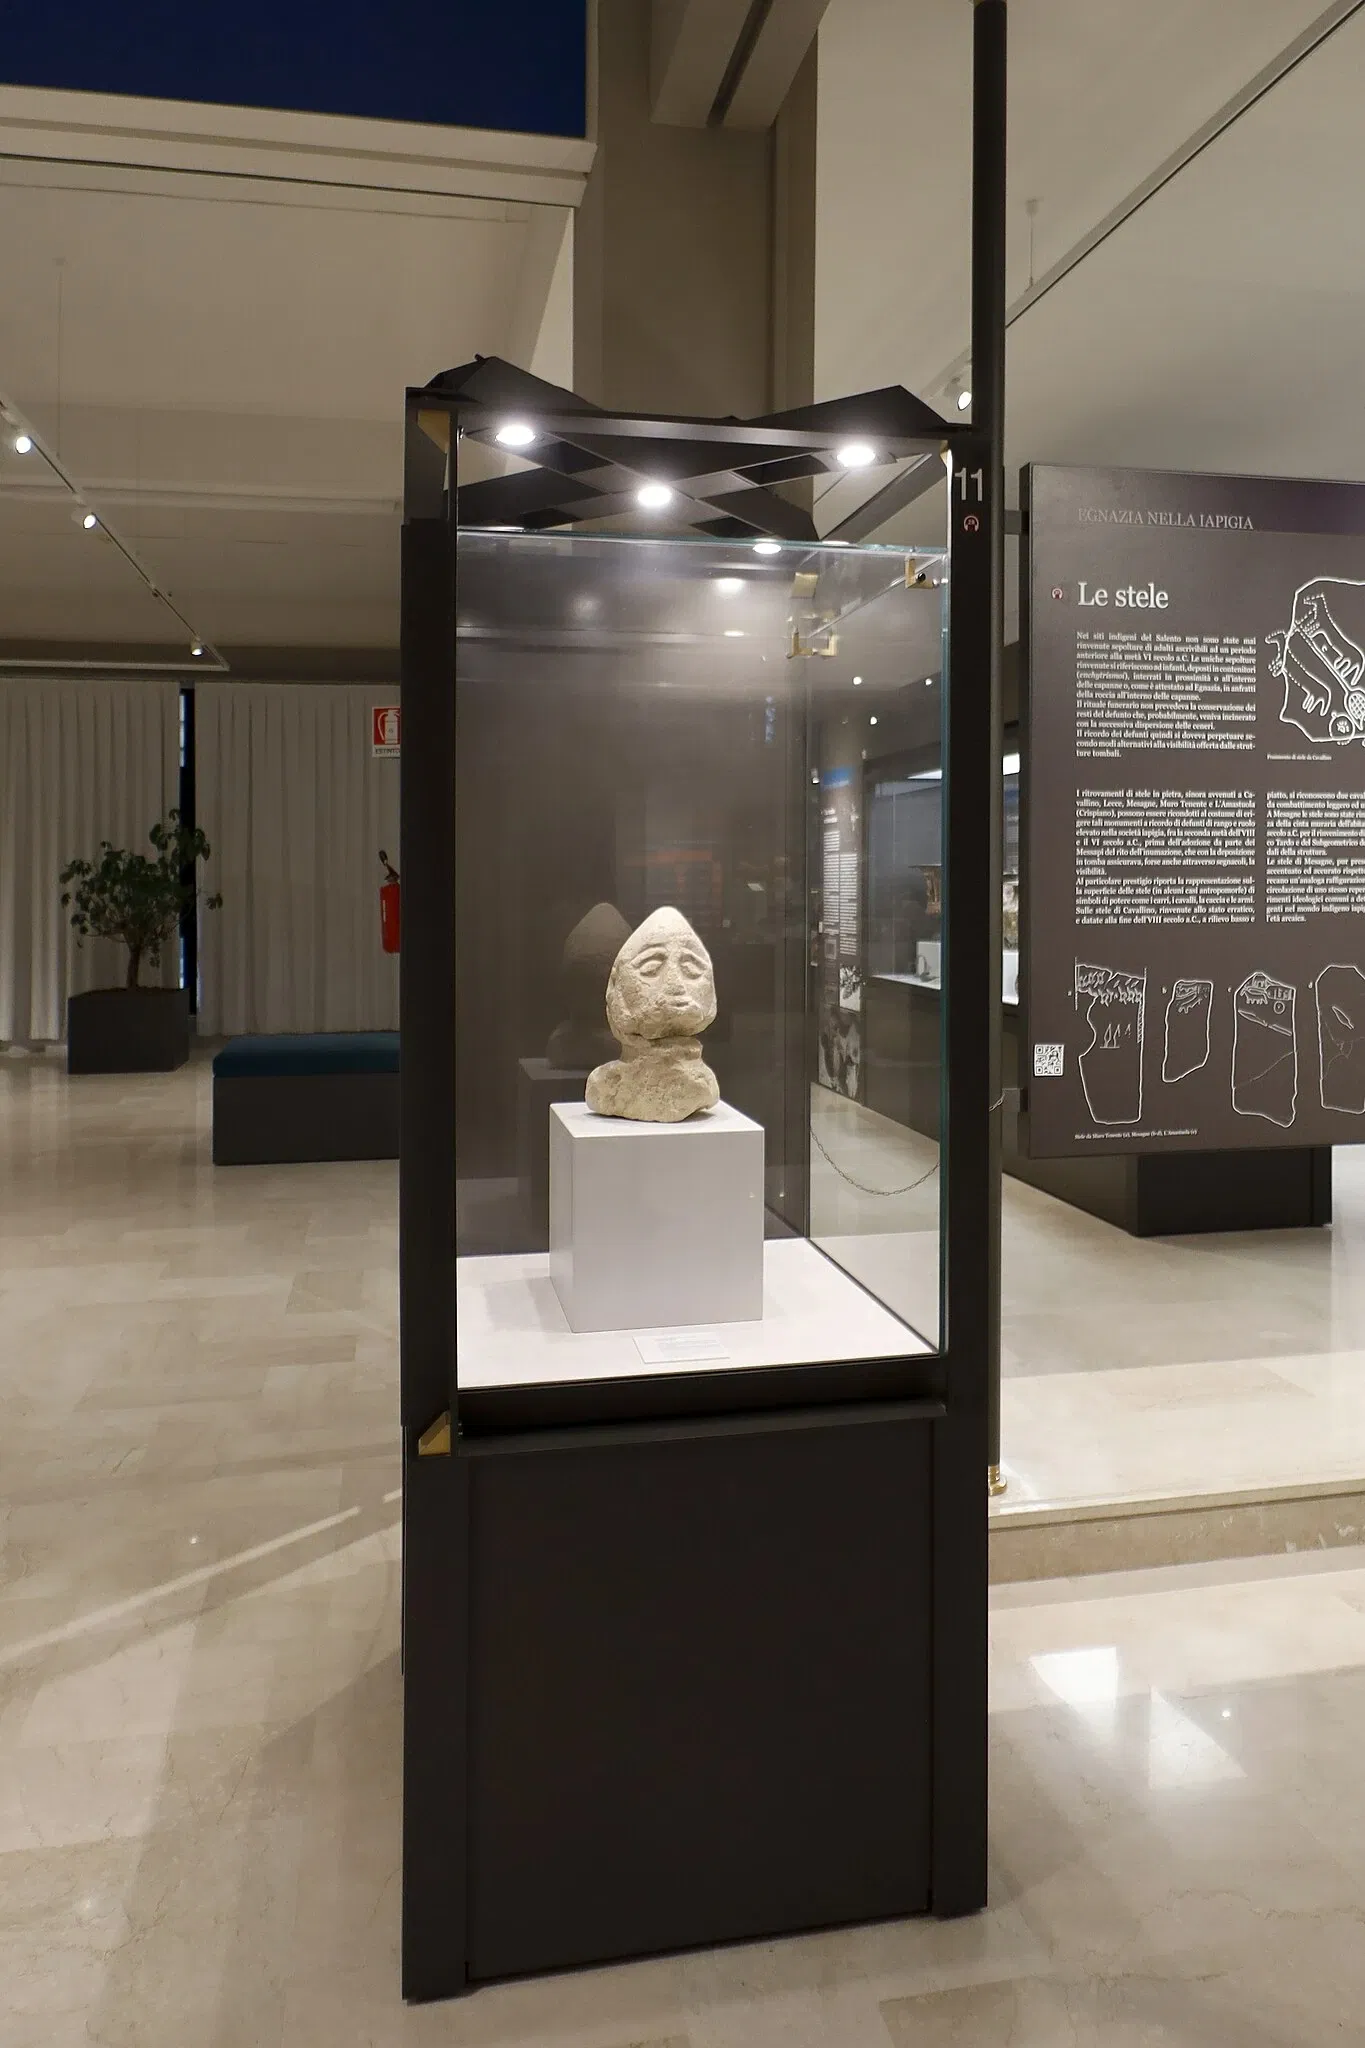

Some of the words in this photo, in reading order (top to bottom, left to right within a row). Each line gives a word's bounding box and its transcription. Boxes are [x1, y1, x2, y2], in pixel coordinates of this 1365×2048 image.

[954, 468, 982, 501] 11
[1078, 508, 1143, 524] EGNAZIA
[1148, 511, 1196, 527] NELLA
[1200, 514, 1253, 530] IAPIGIA
[1078, 582, 1108, 607] Le
[1115, 582, 1168, 609] stele
